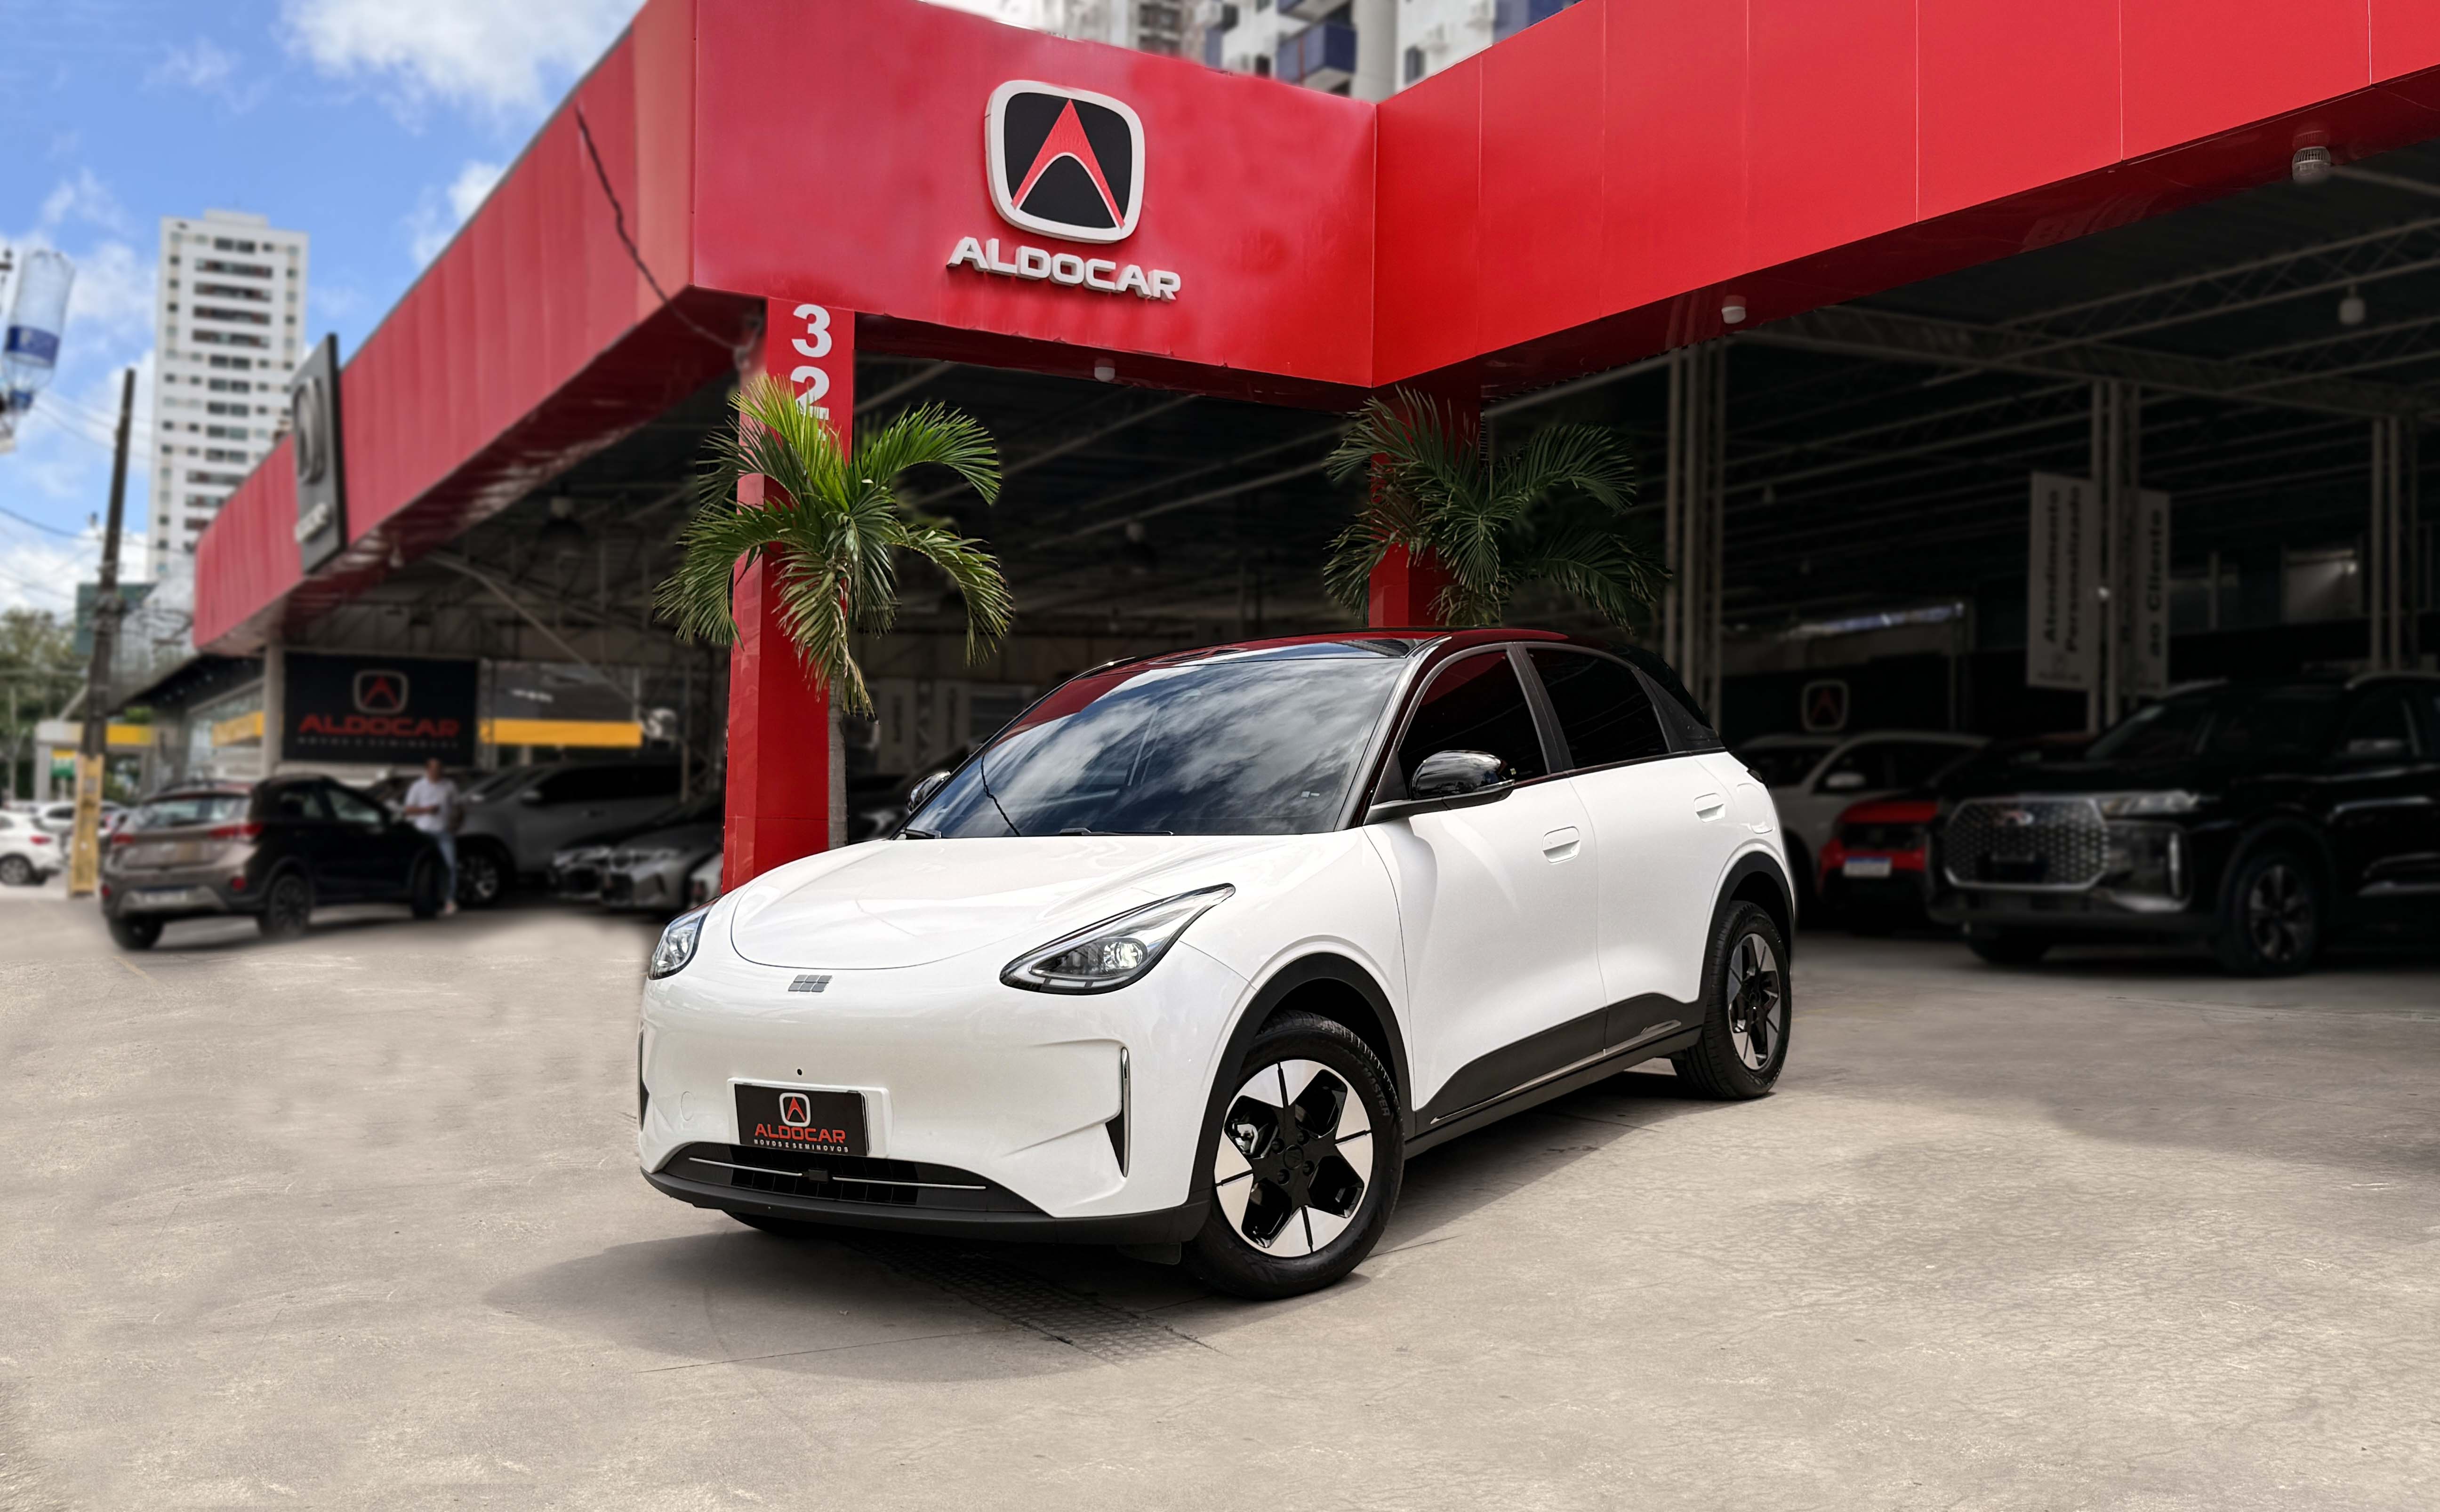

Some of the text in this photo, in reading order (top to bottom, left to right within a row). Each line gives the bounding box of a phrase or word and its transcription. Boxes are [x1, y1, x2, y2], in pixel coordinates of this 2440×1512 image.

[947, 236, 1181, 301] ALDOCAR
[299, 713, 459, 737] ALDOCAR
[754, 1123, 846, 1144] ALDOCAR
[754, 1139, 782, 1147] NOVOS
[793, 1143, 849, 1152] SEMINOVOS
